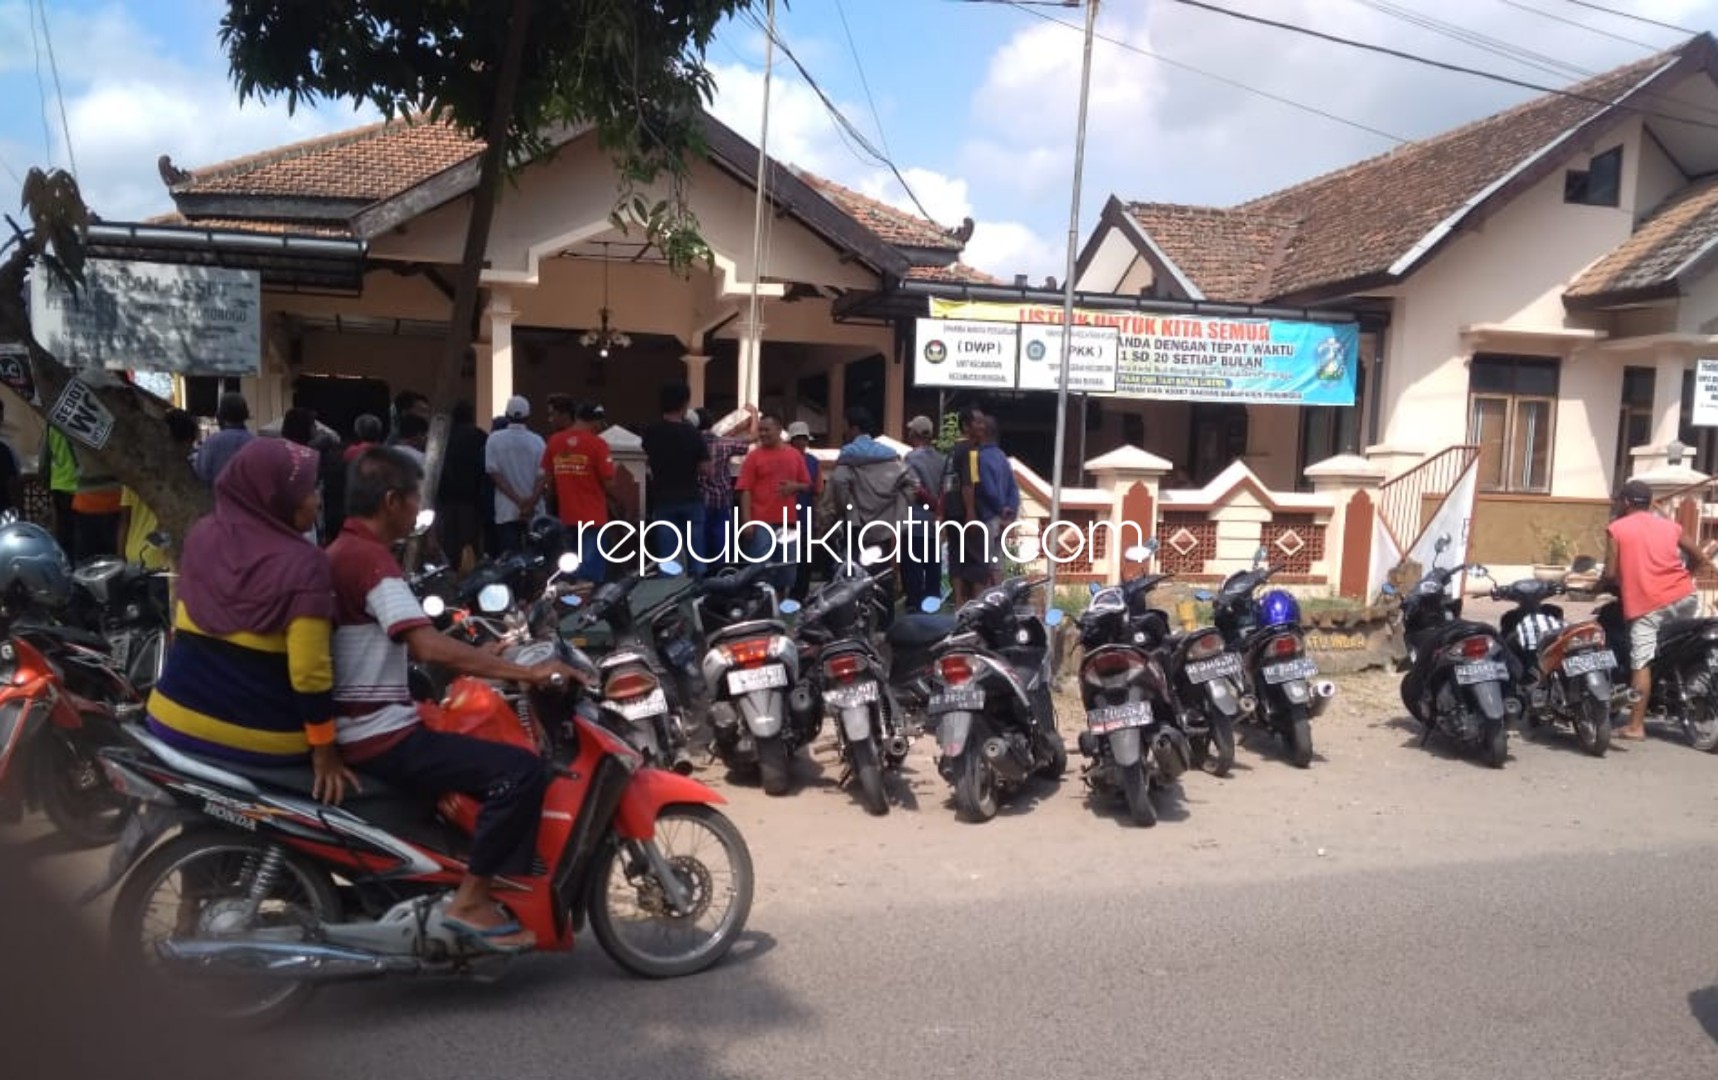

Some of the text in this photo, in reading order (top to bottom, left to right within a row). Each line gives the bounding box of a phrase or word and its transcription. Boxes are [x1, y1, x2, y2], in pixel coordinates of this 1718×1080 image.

[1094, 314, 1155, 335] UNTUK
[1161, 319, 1202, 338] KITA
[1207, 322, 1270, 341] SEMUA
[1132, 350, 1149, 362] SD
[1154, 352, 1168, 363] 20
[1172, 353, 1217, 366] SETIAP
[1221, 356, 1262, 368] BULAN
[1154, 338, 1206, 352] DENGAN
[1211, 342, 1250, 354] TEPAT
[1252, 344, 1293, 356] WAKTU
[55, 383, 85, 423] SEDOT
[203, 801, 257, 832] HONDA
